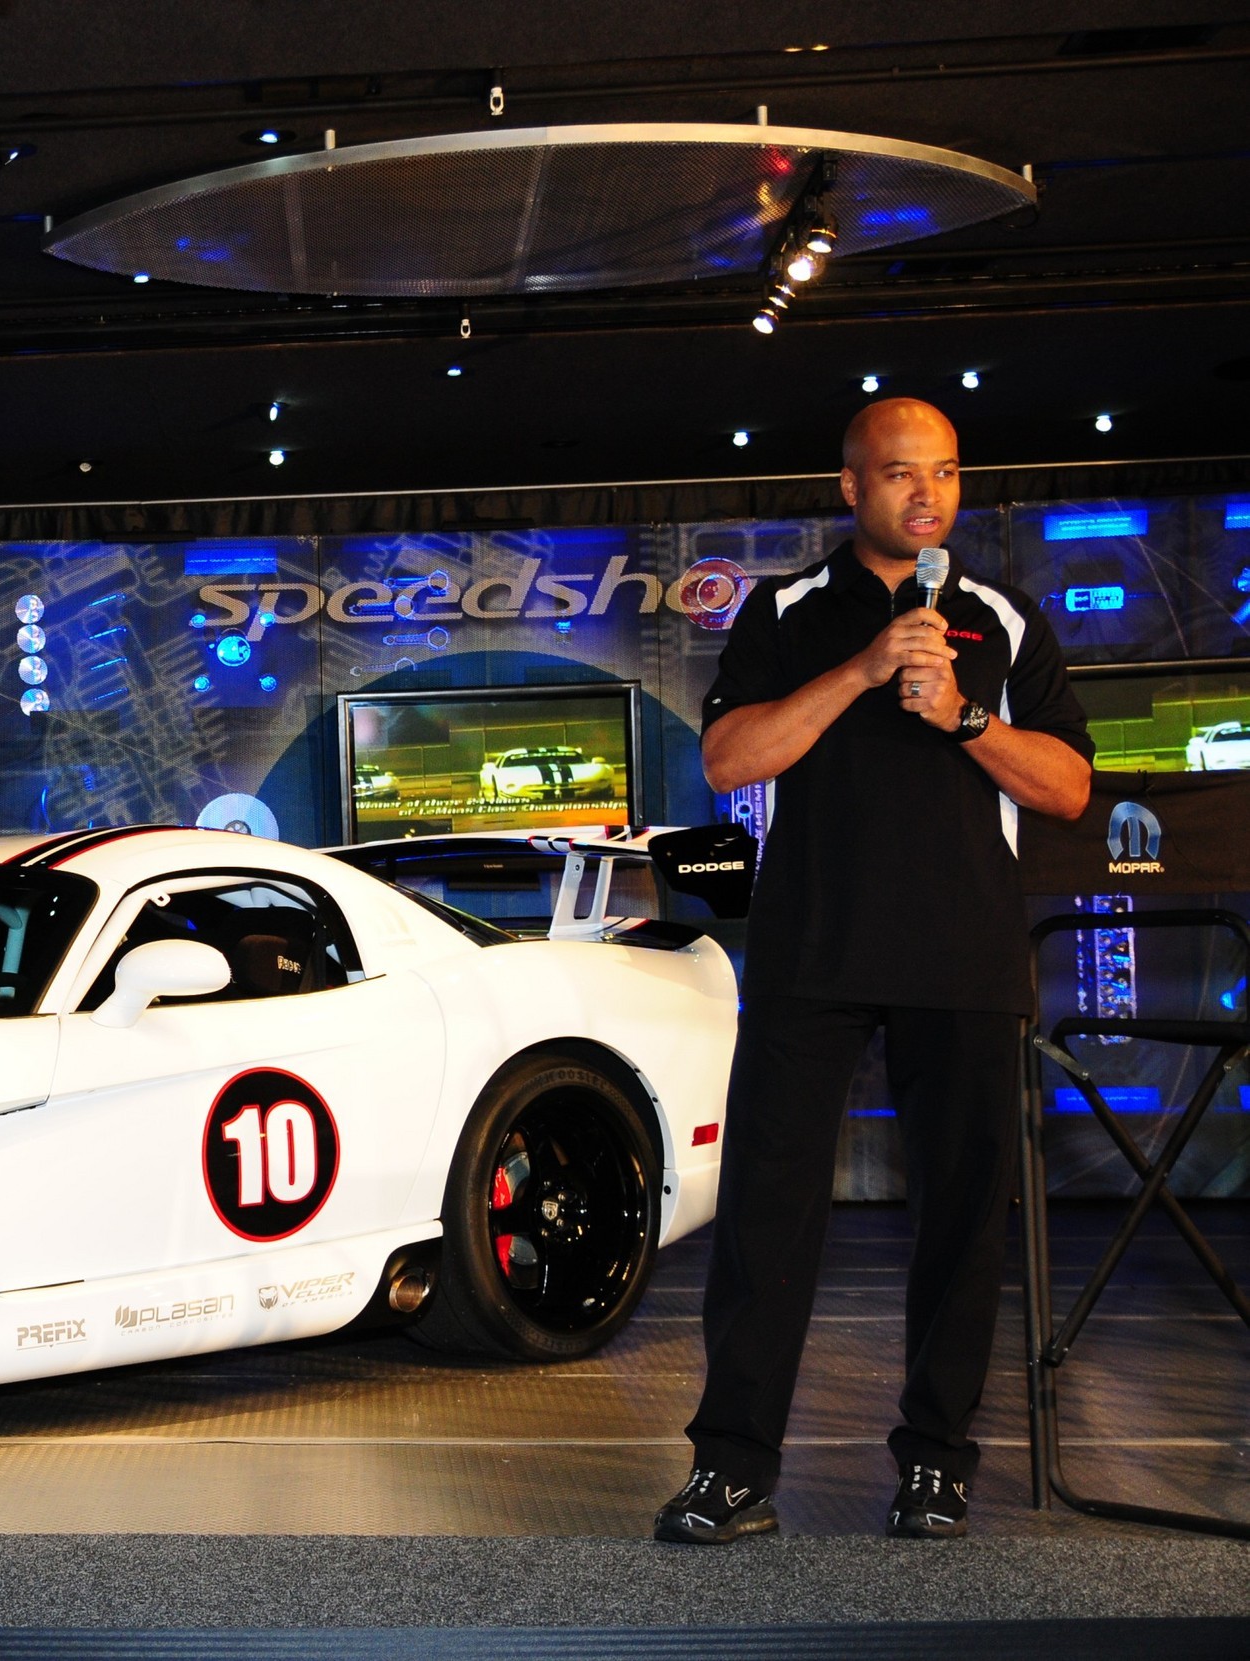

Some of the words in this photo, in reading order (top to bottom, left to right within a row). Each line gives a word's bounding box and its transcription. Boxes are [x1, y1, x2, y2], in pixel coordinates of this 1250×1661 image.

[198, 555, 760, 642] speedsho
[947, 630, 983, 641] DGE
[678, 860, 745, 874] DODGE
[222, 1100, 318, 1207] 10
[280, 1271, 355, 1299] VIPER
[295, 1285, 342, 1299] CLUB
[17, 1318, 86, 1347] PREFIX
